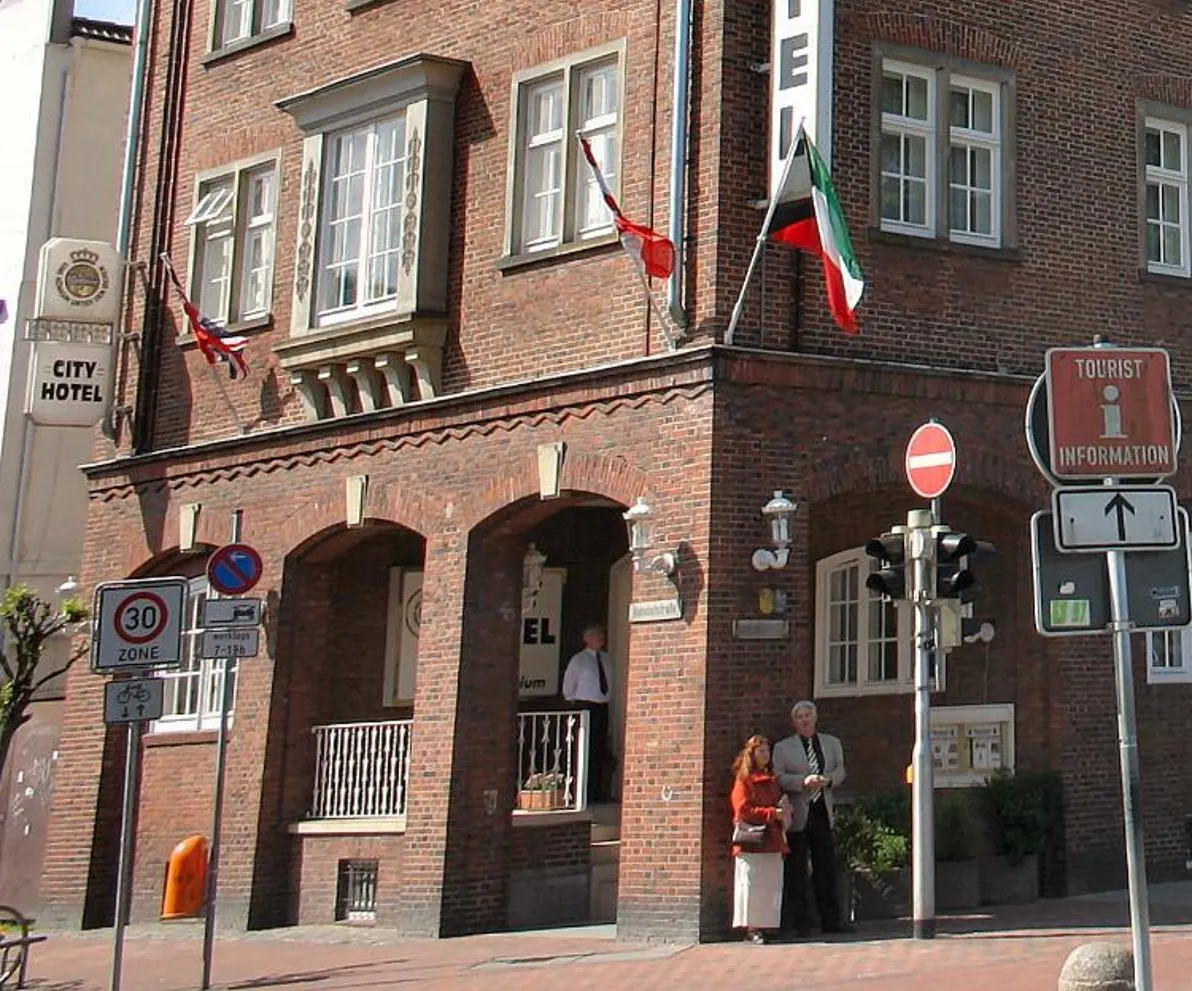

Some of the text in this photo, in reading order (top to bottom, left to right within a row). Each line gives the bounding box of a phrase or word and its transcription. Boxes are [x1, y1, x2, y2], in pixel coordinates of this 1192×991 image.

[53, 360, 97, 379] CITY
[1075, 359, 1144, 379] TOURIST
[41, 382, 103, 402] HOTEL
[1060, 445, 1169, 467] INFORMATION
[124, 605, 157, 631] 30
[118, 646, 160, 662] ZONE
